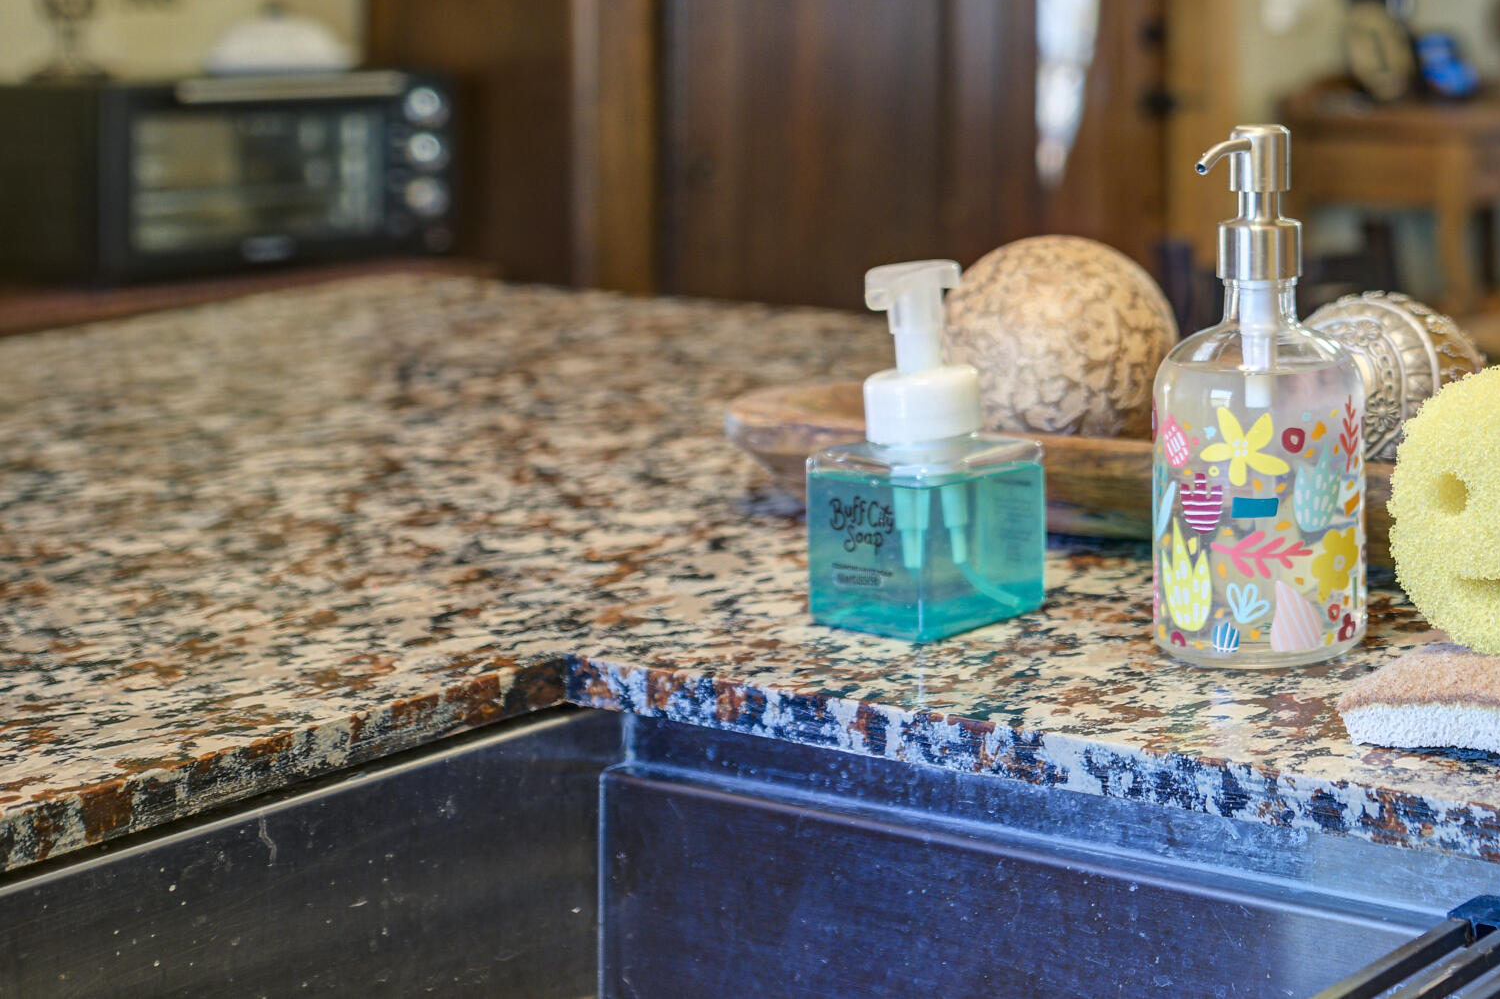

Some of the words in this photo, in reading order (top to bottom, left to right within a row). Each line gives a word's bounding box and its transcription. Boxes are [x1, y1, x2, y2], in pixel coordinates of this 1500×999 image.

[829, 496, 866, 530] Buff
[867, 501, 894, 534] City
[843, 525, 884, 556] Soap
